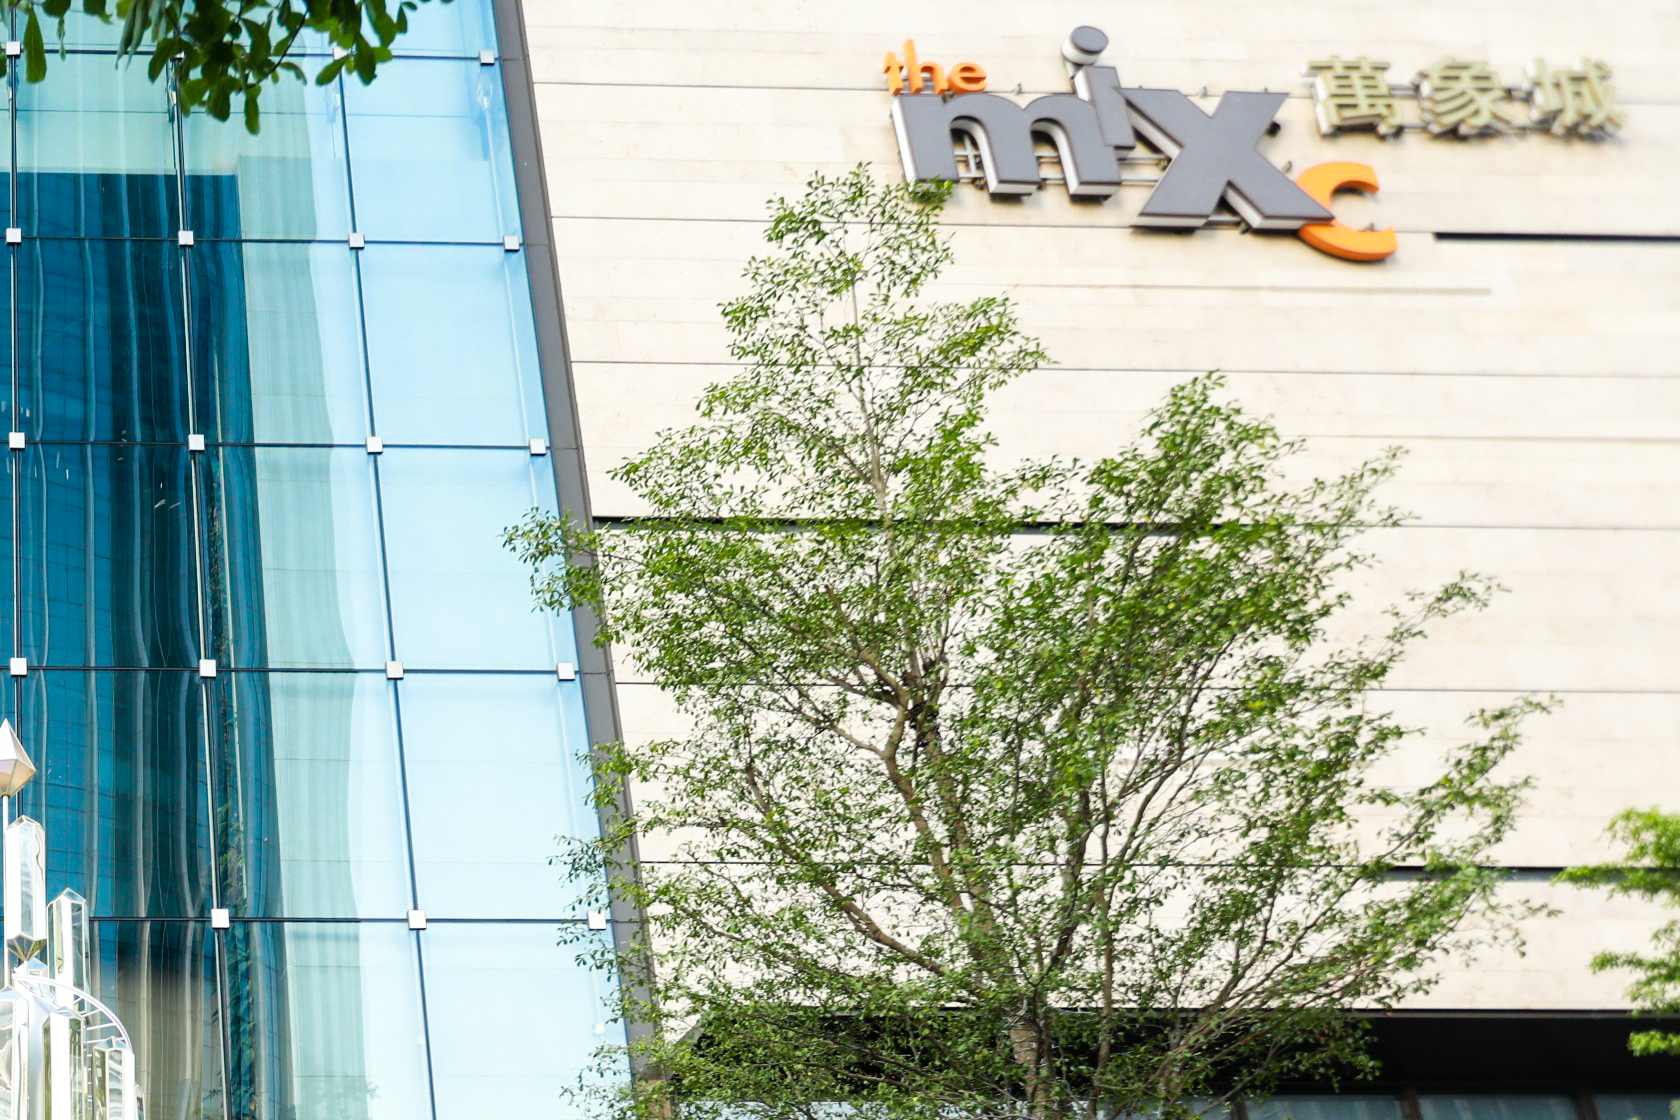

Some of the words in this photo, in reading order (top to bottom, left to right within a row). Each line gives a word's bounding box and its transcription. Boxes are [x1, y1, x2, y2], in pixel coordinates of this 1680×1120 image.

[883, 39, 988, 97] the
[1302, 56, 1626, 136] 萬象城
